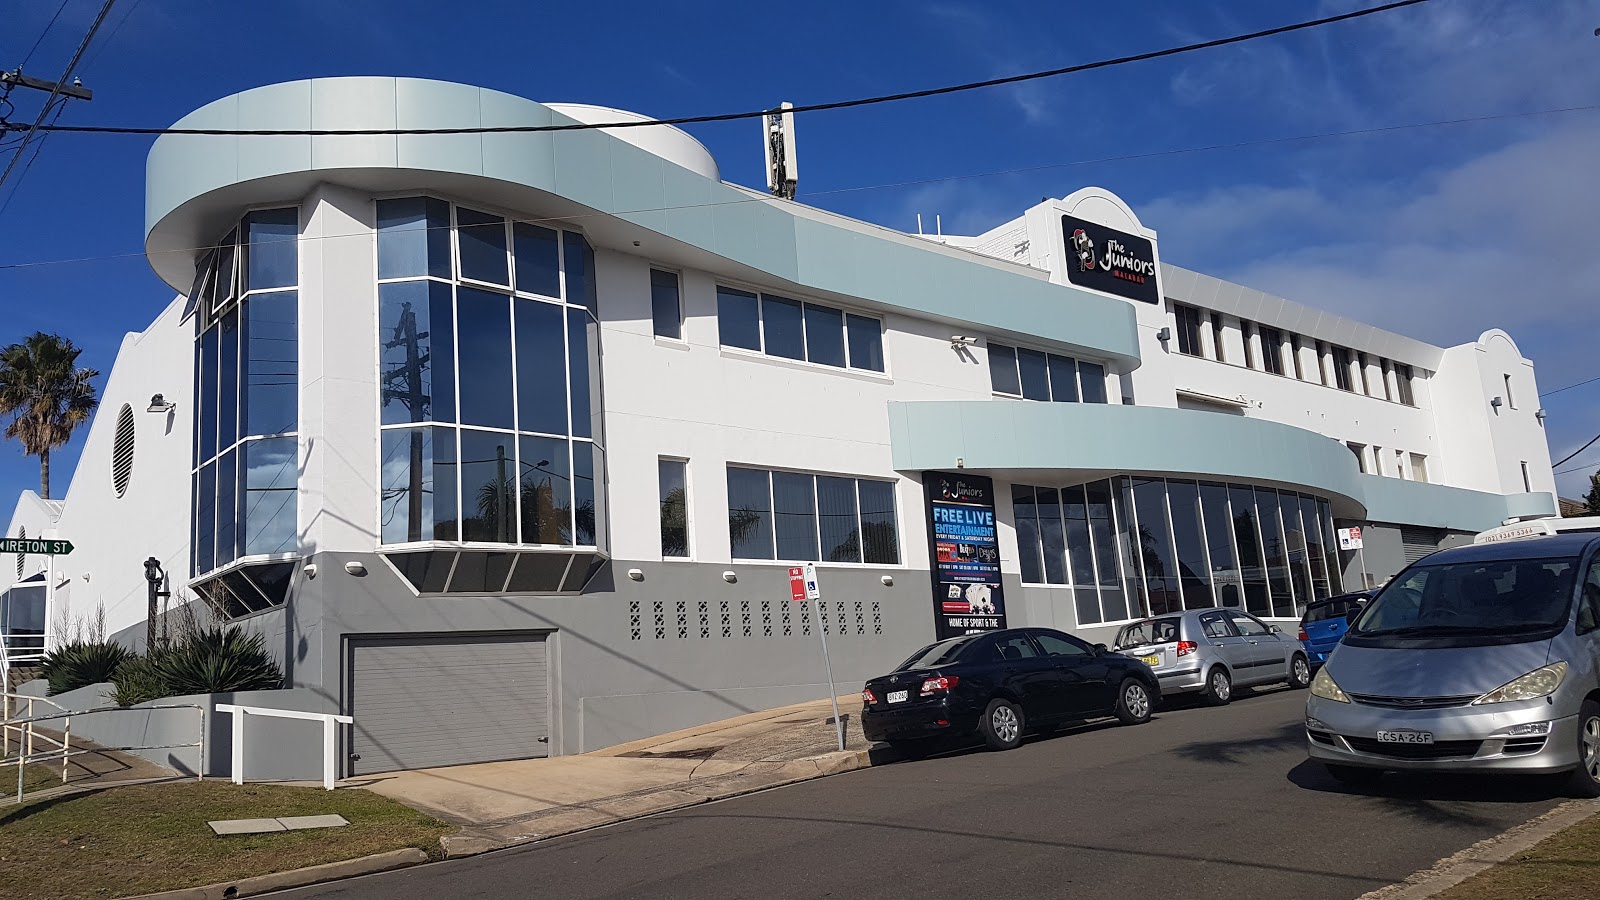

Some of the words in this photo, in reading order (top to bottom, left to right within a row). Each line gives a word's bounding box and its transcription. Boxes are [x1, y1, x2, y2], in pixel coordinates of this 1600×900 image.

[1108, 239, 1125, 253] The
[1099, 241, 1154, 276] Juniors
[1114, 270, 1145, 284] MALABAR
[951, 481, 983, 498] Juniors
[934, 508, 964, 523] FREE
[965, 510, 993, 525] LIVE
[935, 524, 993, 536] ENTERTAINMENT
[1485, 535, 1498, 543] (02)
[6, 540, 47, 552] IRETON
[53, 542, 68, 553] ST
[949, 617, 963, 628] HOME
[963, 617, 970, 628] OF
[970, 618, 985, 628] SPORT
[989, 618, 998, 627] THE
